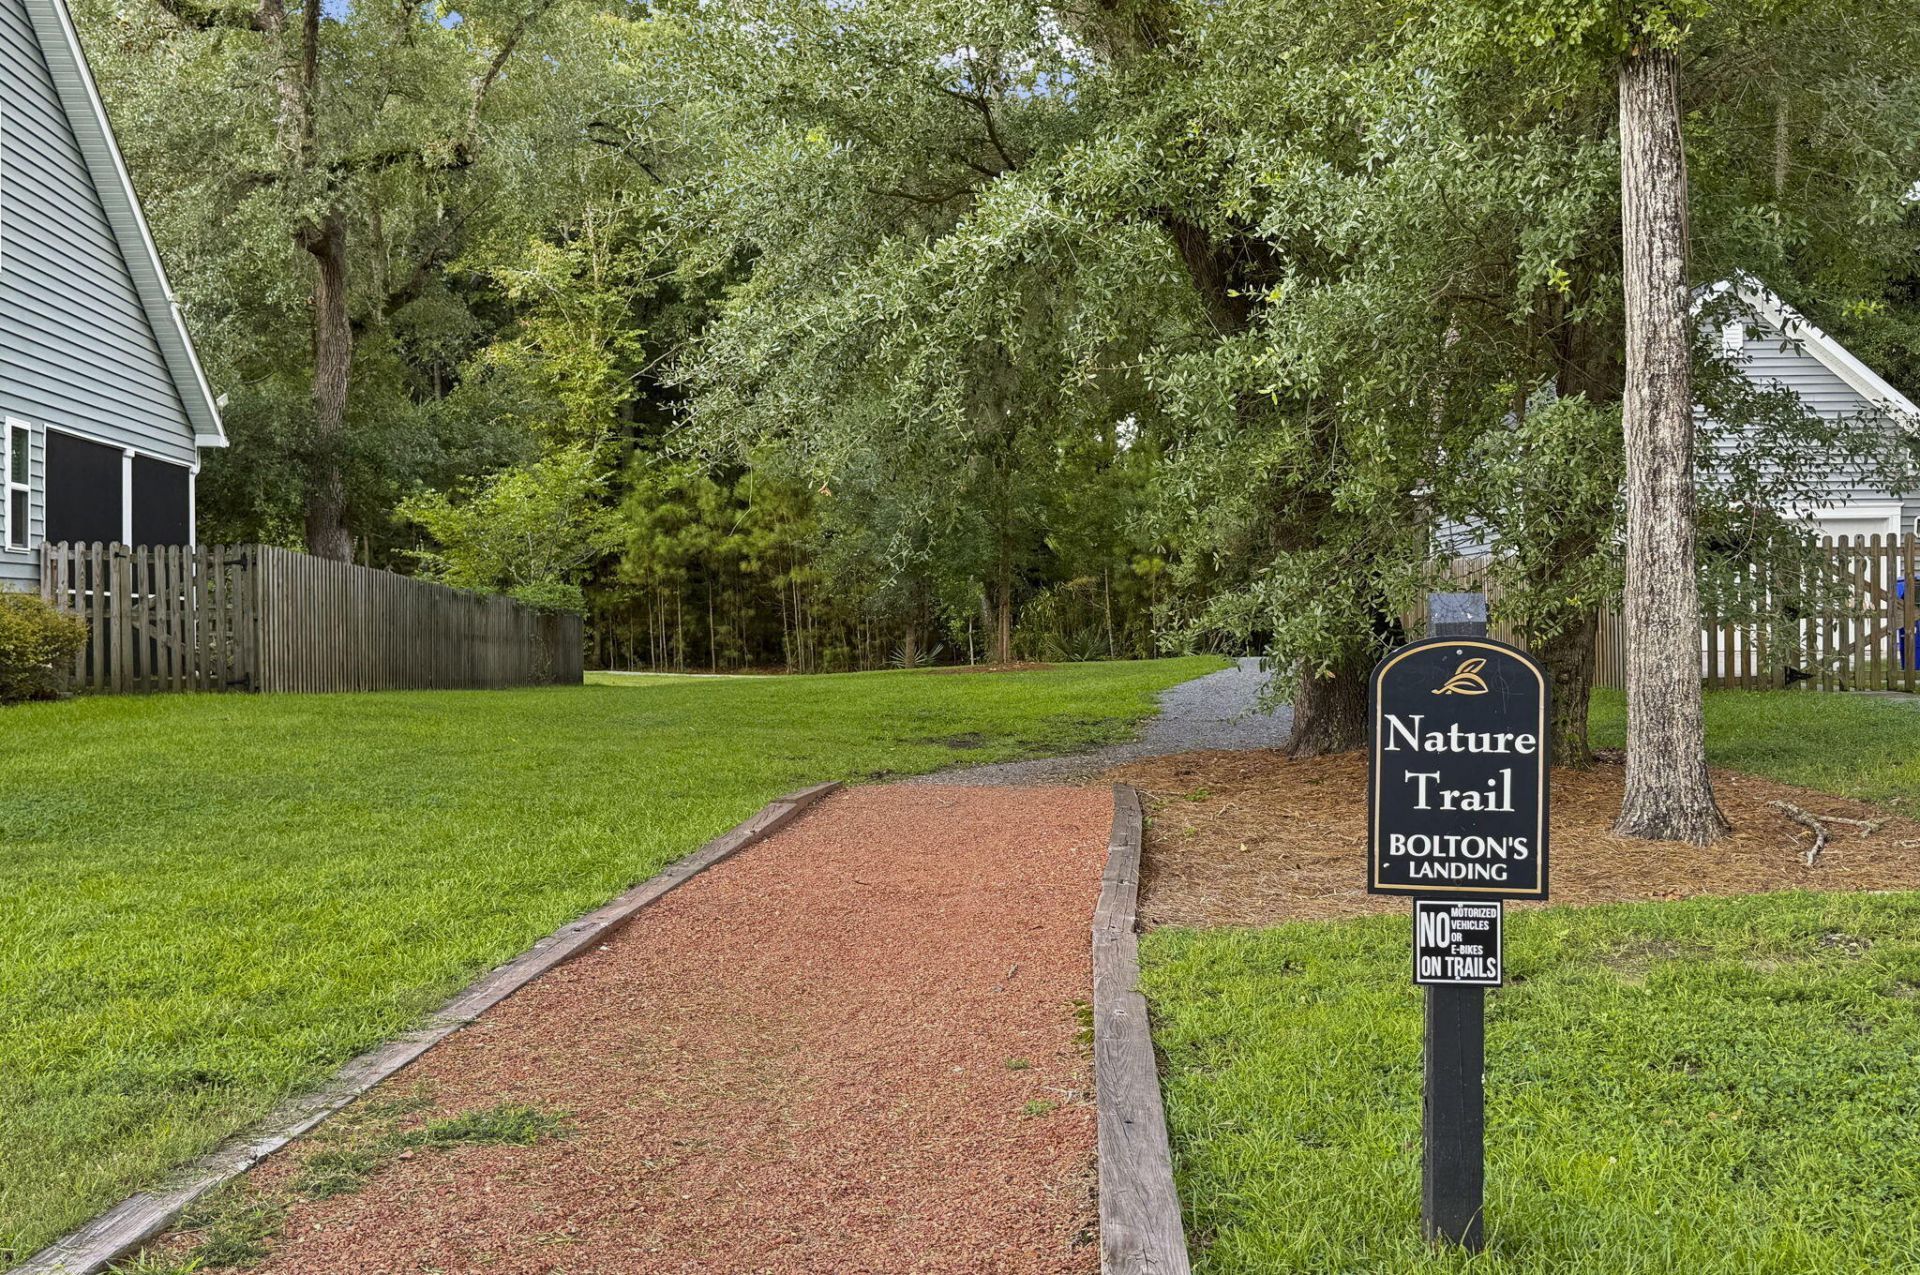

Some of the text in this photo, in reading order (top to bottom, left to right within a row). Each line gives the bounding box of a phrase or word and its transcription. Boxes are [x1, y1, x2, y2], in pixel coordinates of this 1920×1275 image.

[1384, 714, 1536, 754] Nature
[1405, 768, 1515, 812] Trail
[1389, 833, 1529, 860] BOLTON'S
[1409, 861, 1508, 881] LANDING
[1450, 907, 1497, 918] MOTORIZED
[1420, 911, 1450, 948] NO
[1451, 919, 1489, 930] VEHICLES
[1451, 932, 1462, 942] OR
[1451, 944, 1483, 955] E-BIKES
[1421, 955, 1497, 978] ON TRAILS
